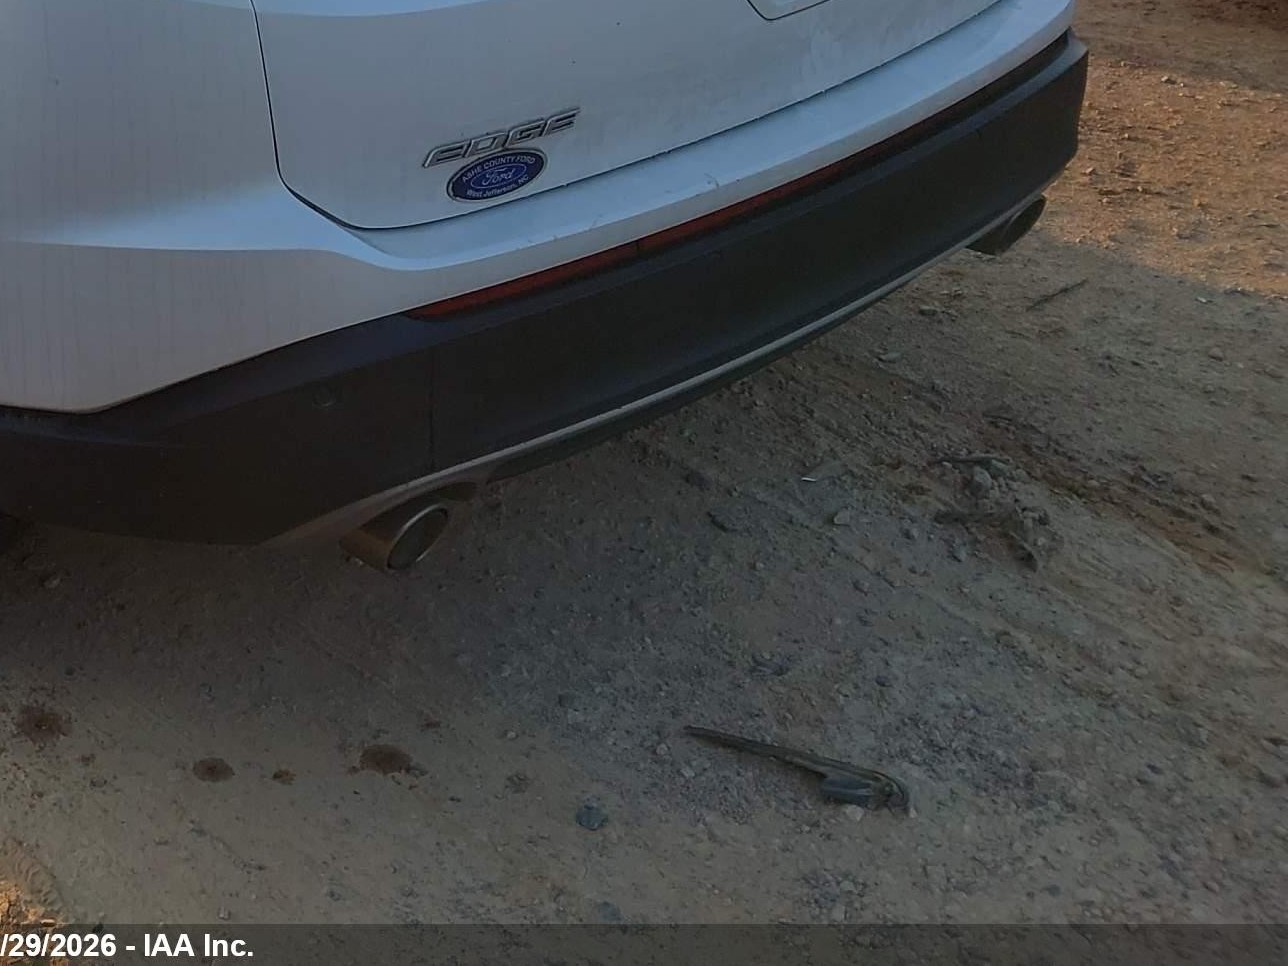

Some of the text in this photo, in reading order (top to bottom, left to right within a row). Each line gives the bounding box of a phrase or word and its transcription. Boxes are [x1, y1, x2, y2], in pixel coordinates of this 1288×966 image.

[422, 106, 581, 169] EDGE
[462, 154, 537, 184] ASHE COUNTY FORD
[481, 167, 516, 187] Ford
